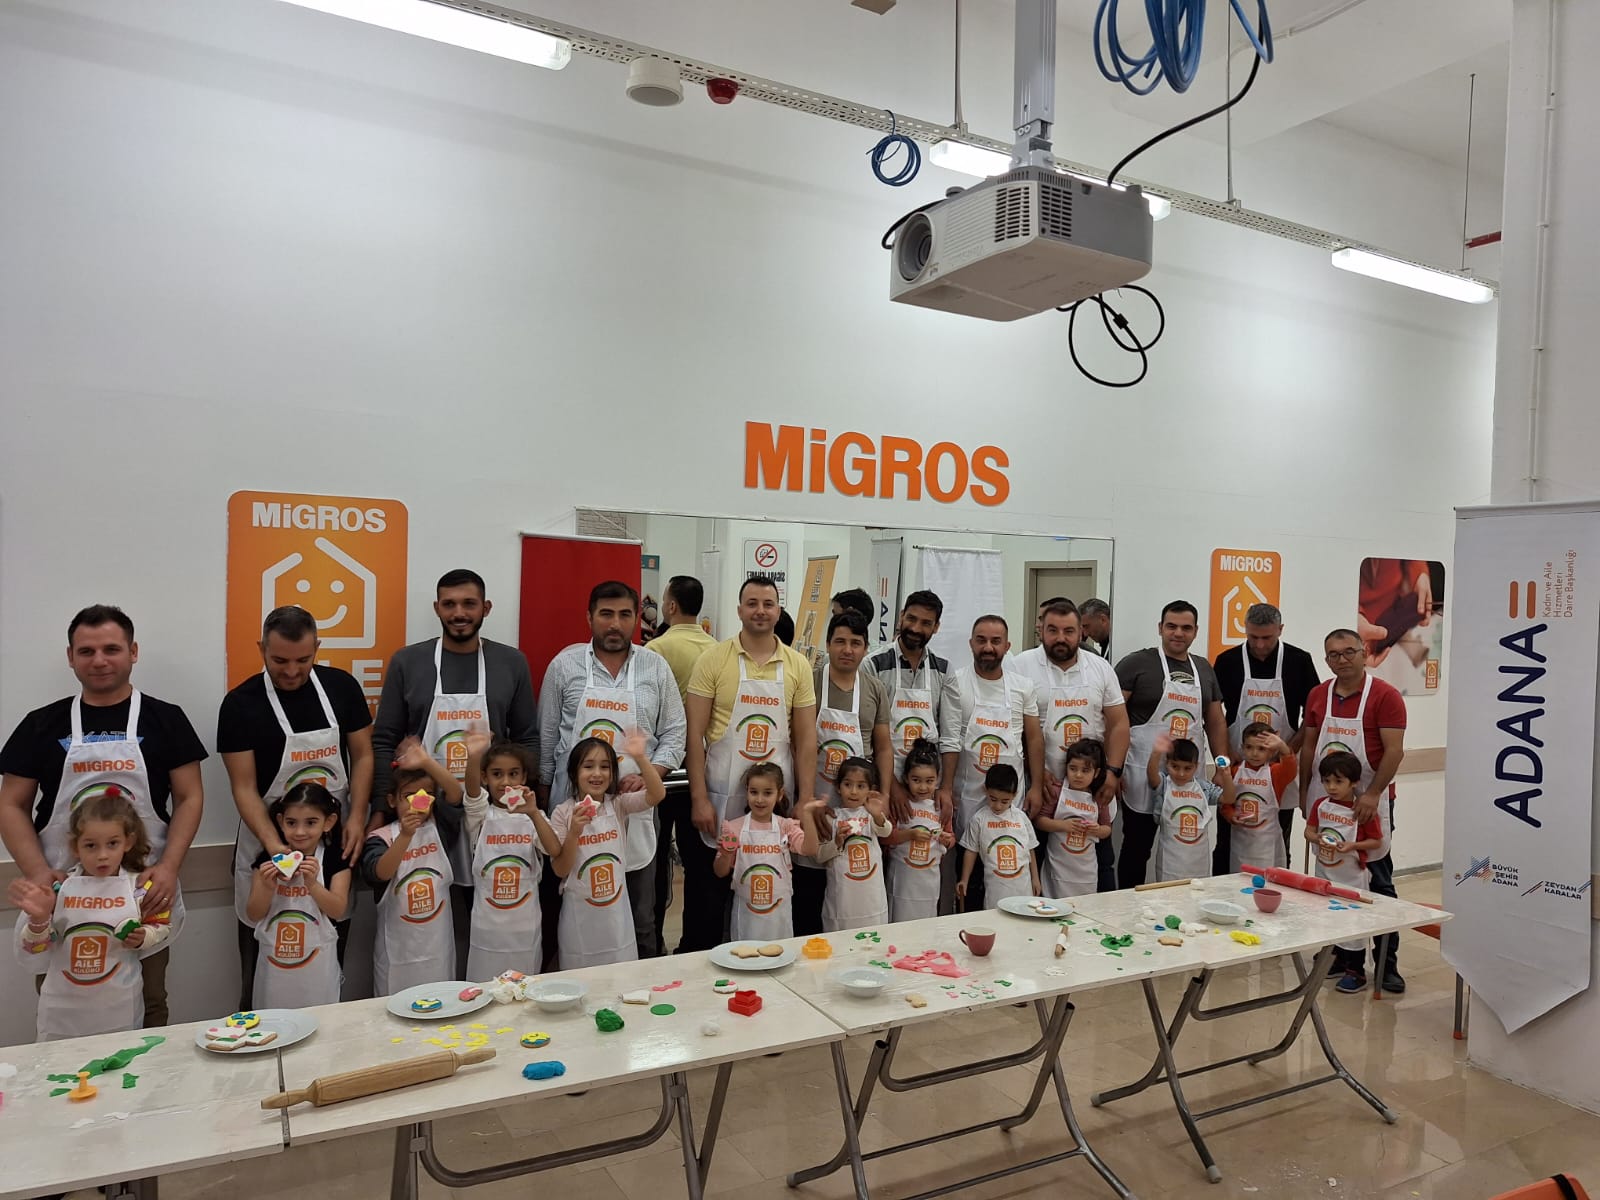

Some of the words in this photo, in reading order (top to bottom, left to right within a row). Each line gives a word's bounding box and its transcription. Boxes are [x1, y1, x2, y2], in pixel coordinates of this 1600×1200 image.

[1543, 561, 1553, 579] Aile
[1545, 581, 1552, 591] ve
[1564, 594, 1573, 618] Daire
[1494, 623, 1548, 829] ADANA
[1491, 863, 1519, 874] BÜYÜK
[1491, 878, 1519, 888] ADANA
[1544, 881, 1577, 893] ZEYDAN
[1544, 887, 1582, 901] KARALAR
